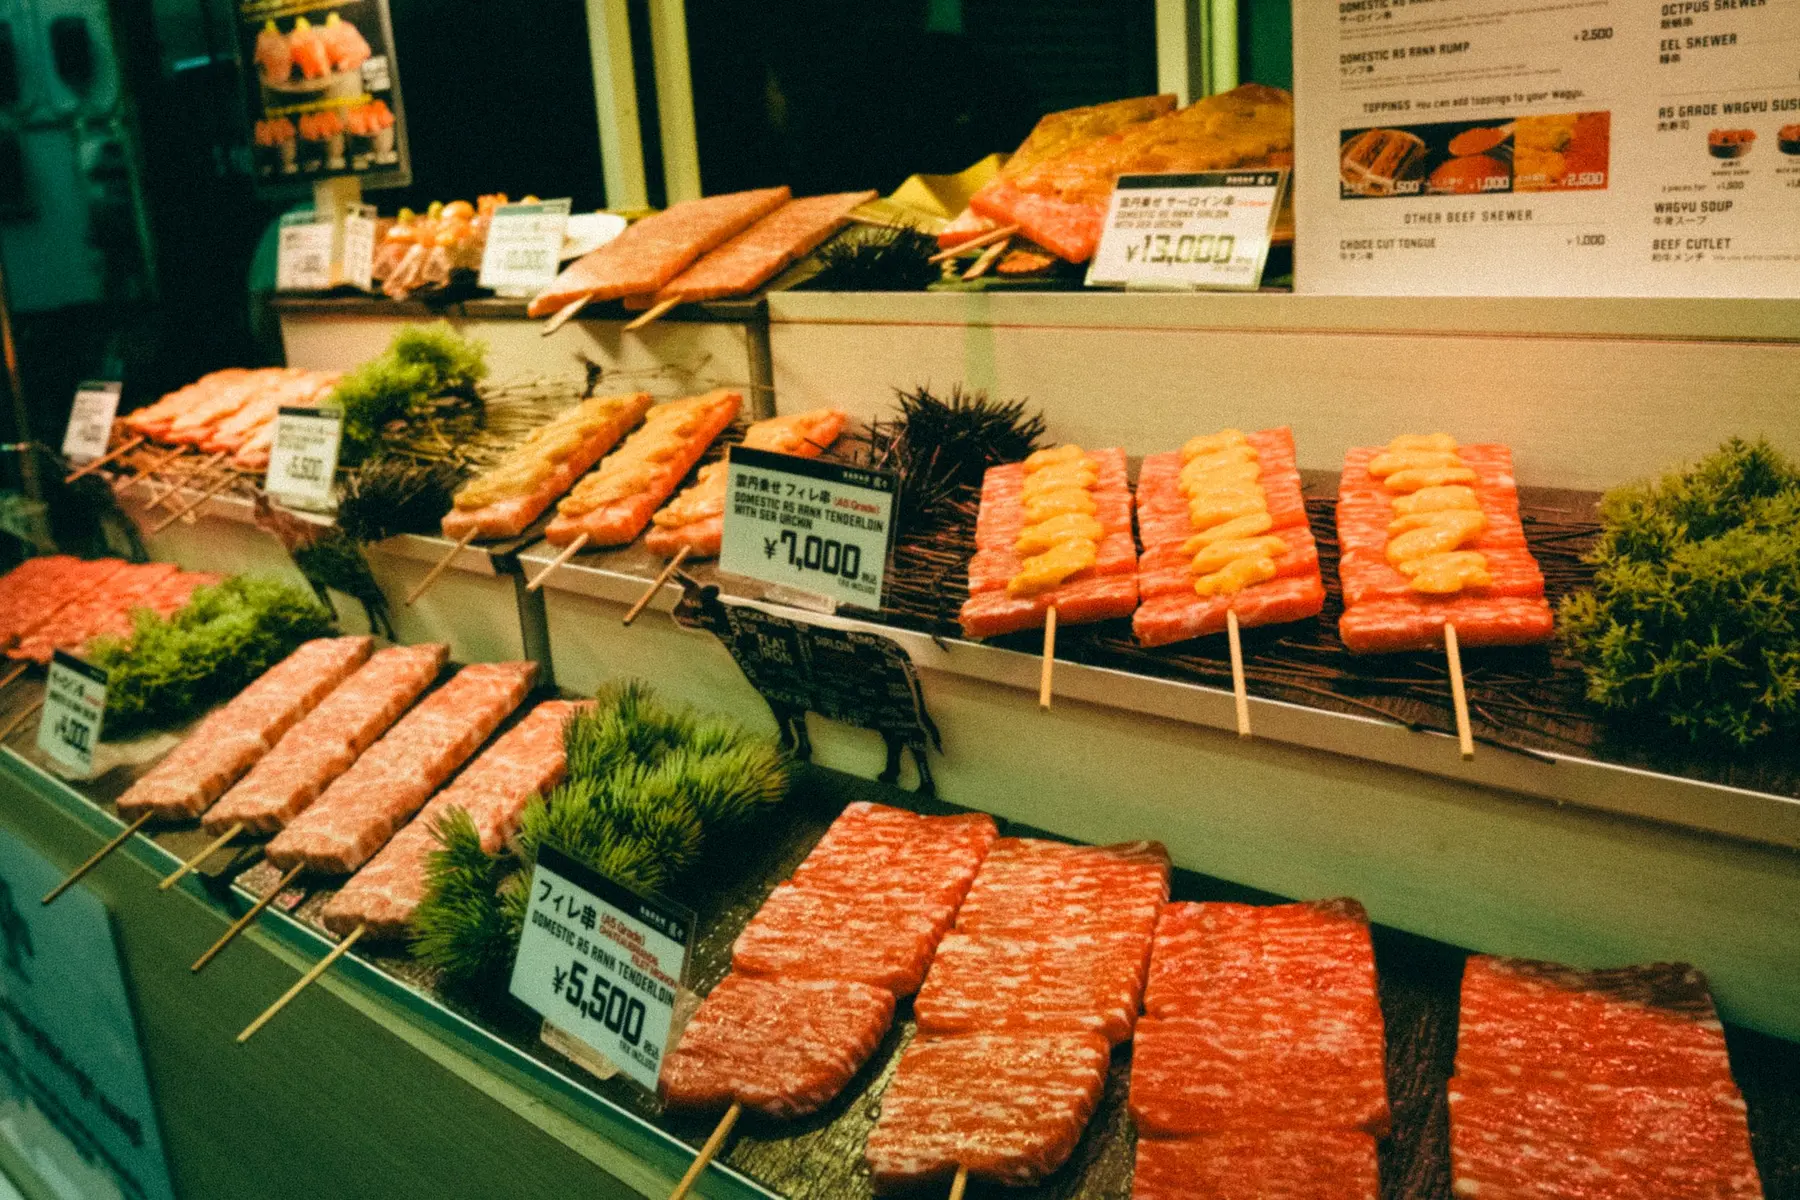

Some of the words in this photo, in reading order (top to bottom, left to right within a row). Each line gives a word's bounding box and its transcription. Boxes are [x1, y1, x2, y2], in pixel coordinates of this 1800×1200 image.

[1662, 1, 1709, 16] OCTPUS
[1340, 49, 1388, 64] DOMESTIC
[1409, 45, 1435, 57] RANK
[1439, 41, 1470, 54] RUMP
[1660, 39, 1681, 51] EEL
[1686, 33, 1737, 49] SKEWER
[1363, 100, 1411, 113] TOPPINGS
[1471, 94, 1511, 106] toppings
[1514, 92, 1524, 101] to
[1679, 104, 1718, 117] GRADE
[1723, 101, 1768, 115] WAGYU
[1404, 213, 1441, 224] OTHER
[1446, 211, 1476, 223] BEEF
[1482, 209, 1533, 222] SKEWER
[1654, 202, 1697, 213] WAGYU
[1701, 200, 1733, 213] SOUP
[1340, 239, 1373, 251] CHOICE
[1377, 238, 1395, 250] CUT
[1399, 237, 1436, 249] TONGUE
[1652, 240, 1681, 251] BEEF
[1686, 237, 1731, 250] CUTLET
[785, 483, 831, 504] フィレ串
[734, 491, 780, 510] DOMESTIC
[798, 504, 822, 518] RANK
[825, 508, 884, 533] TENDERLOIN
[734, 504, 758, 519] WITH
[779, 512, 813, 530] URCHIN
[763, 528, 861, 581] ¥7,000
[540, 879, 597, 932] フィレ串
[531, 909, 574, 947] DOMESTIC
[590, 944, 616, 971] RANK
[618, 960, 678, 1009] TENDERLOIN
[551, 959, 646, 1047] ¥5,500
